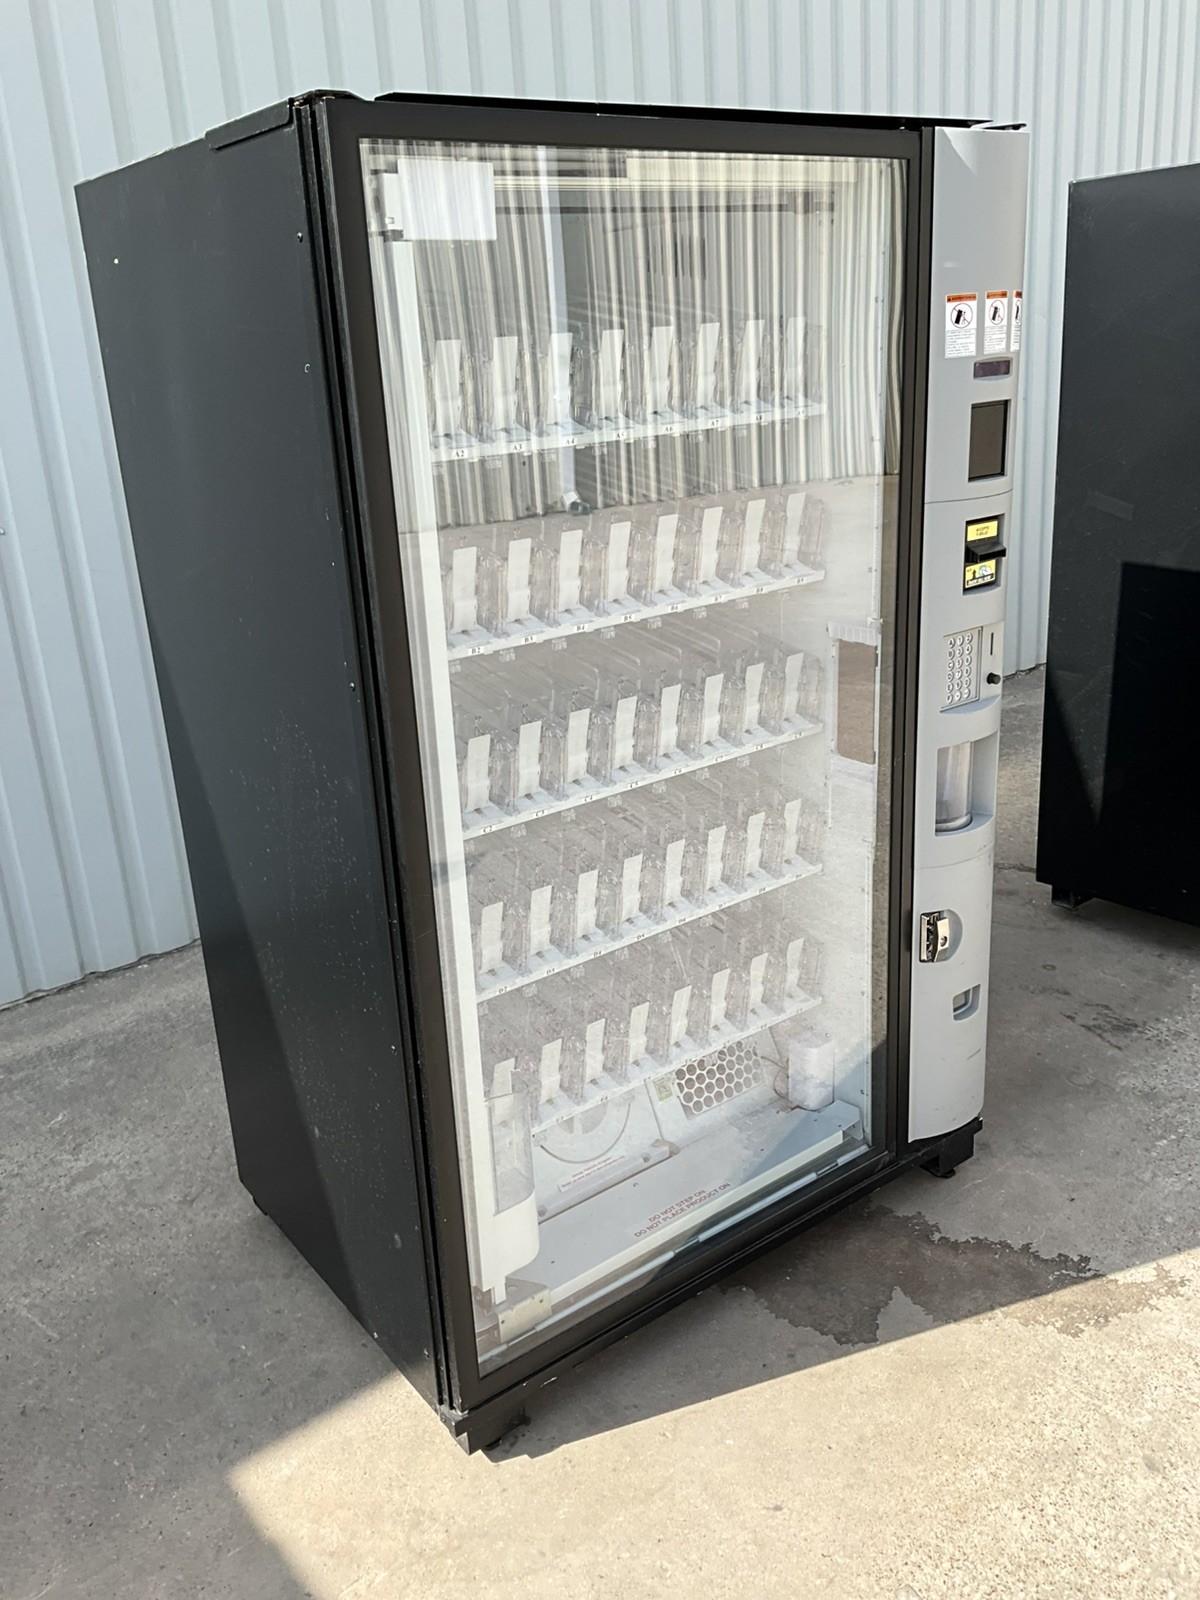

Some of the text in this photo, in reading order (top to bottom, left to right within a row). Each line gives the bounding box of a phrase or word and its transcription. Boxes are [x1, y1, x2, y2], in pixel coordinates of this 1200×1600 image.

[634, 1229, 646, 1237] DO
[647, 1221, 662, 1230] NOT
[662, 1208, 686, 1222] PLACE
[686, 1189, 719, 1208] PRODUCT
[649, 1214, 660, 1222] DO
[661, 1206, 675, 1216] NOT
[676, 1196, 694, 1207] STEP
